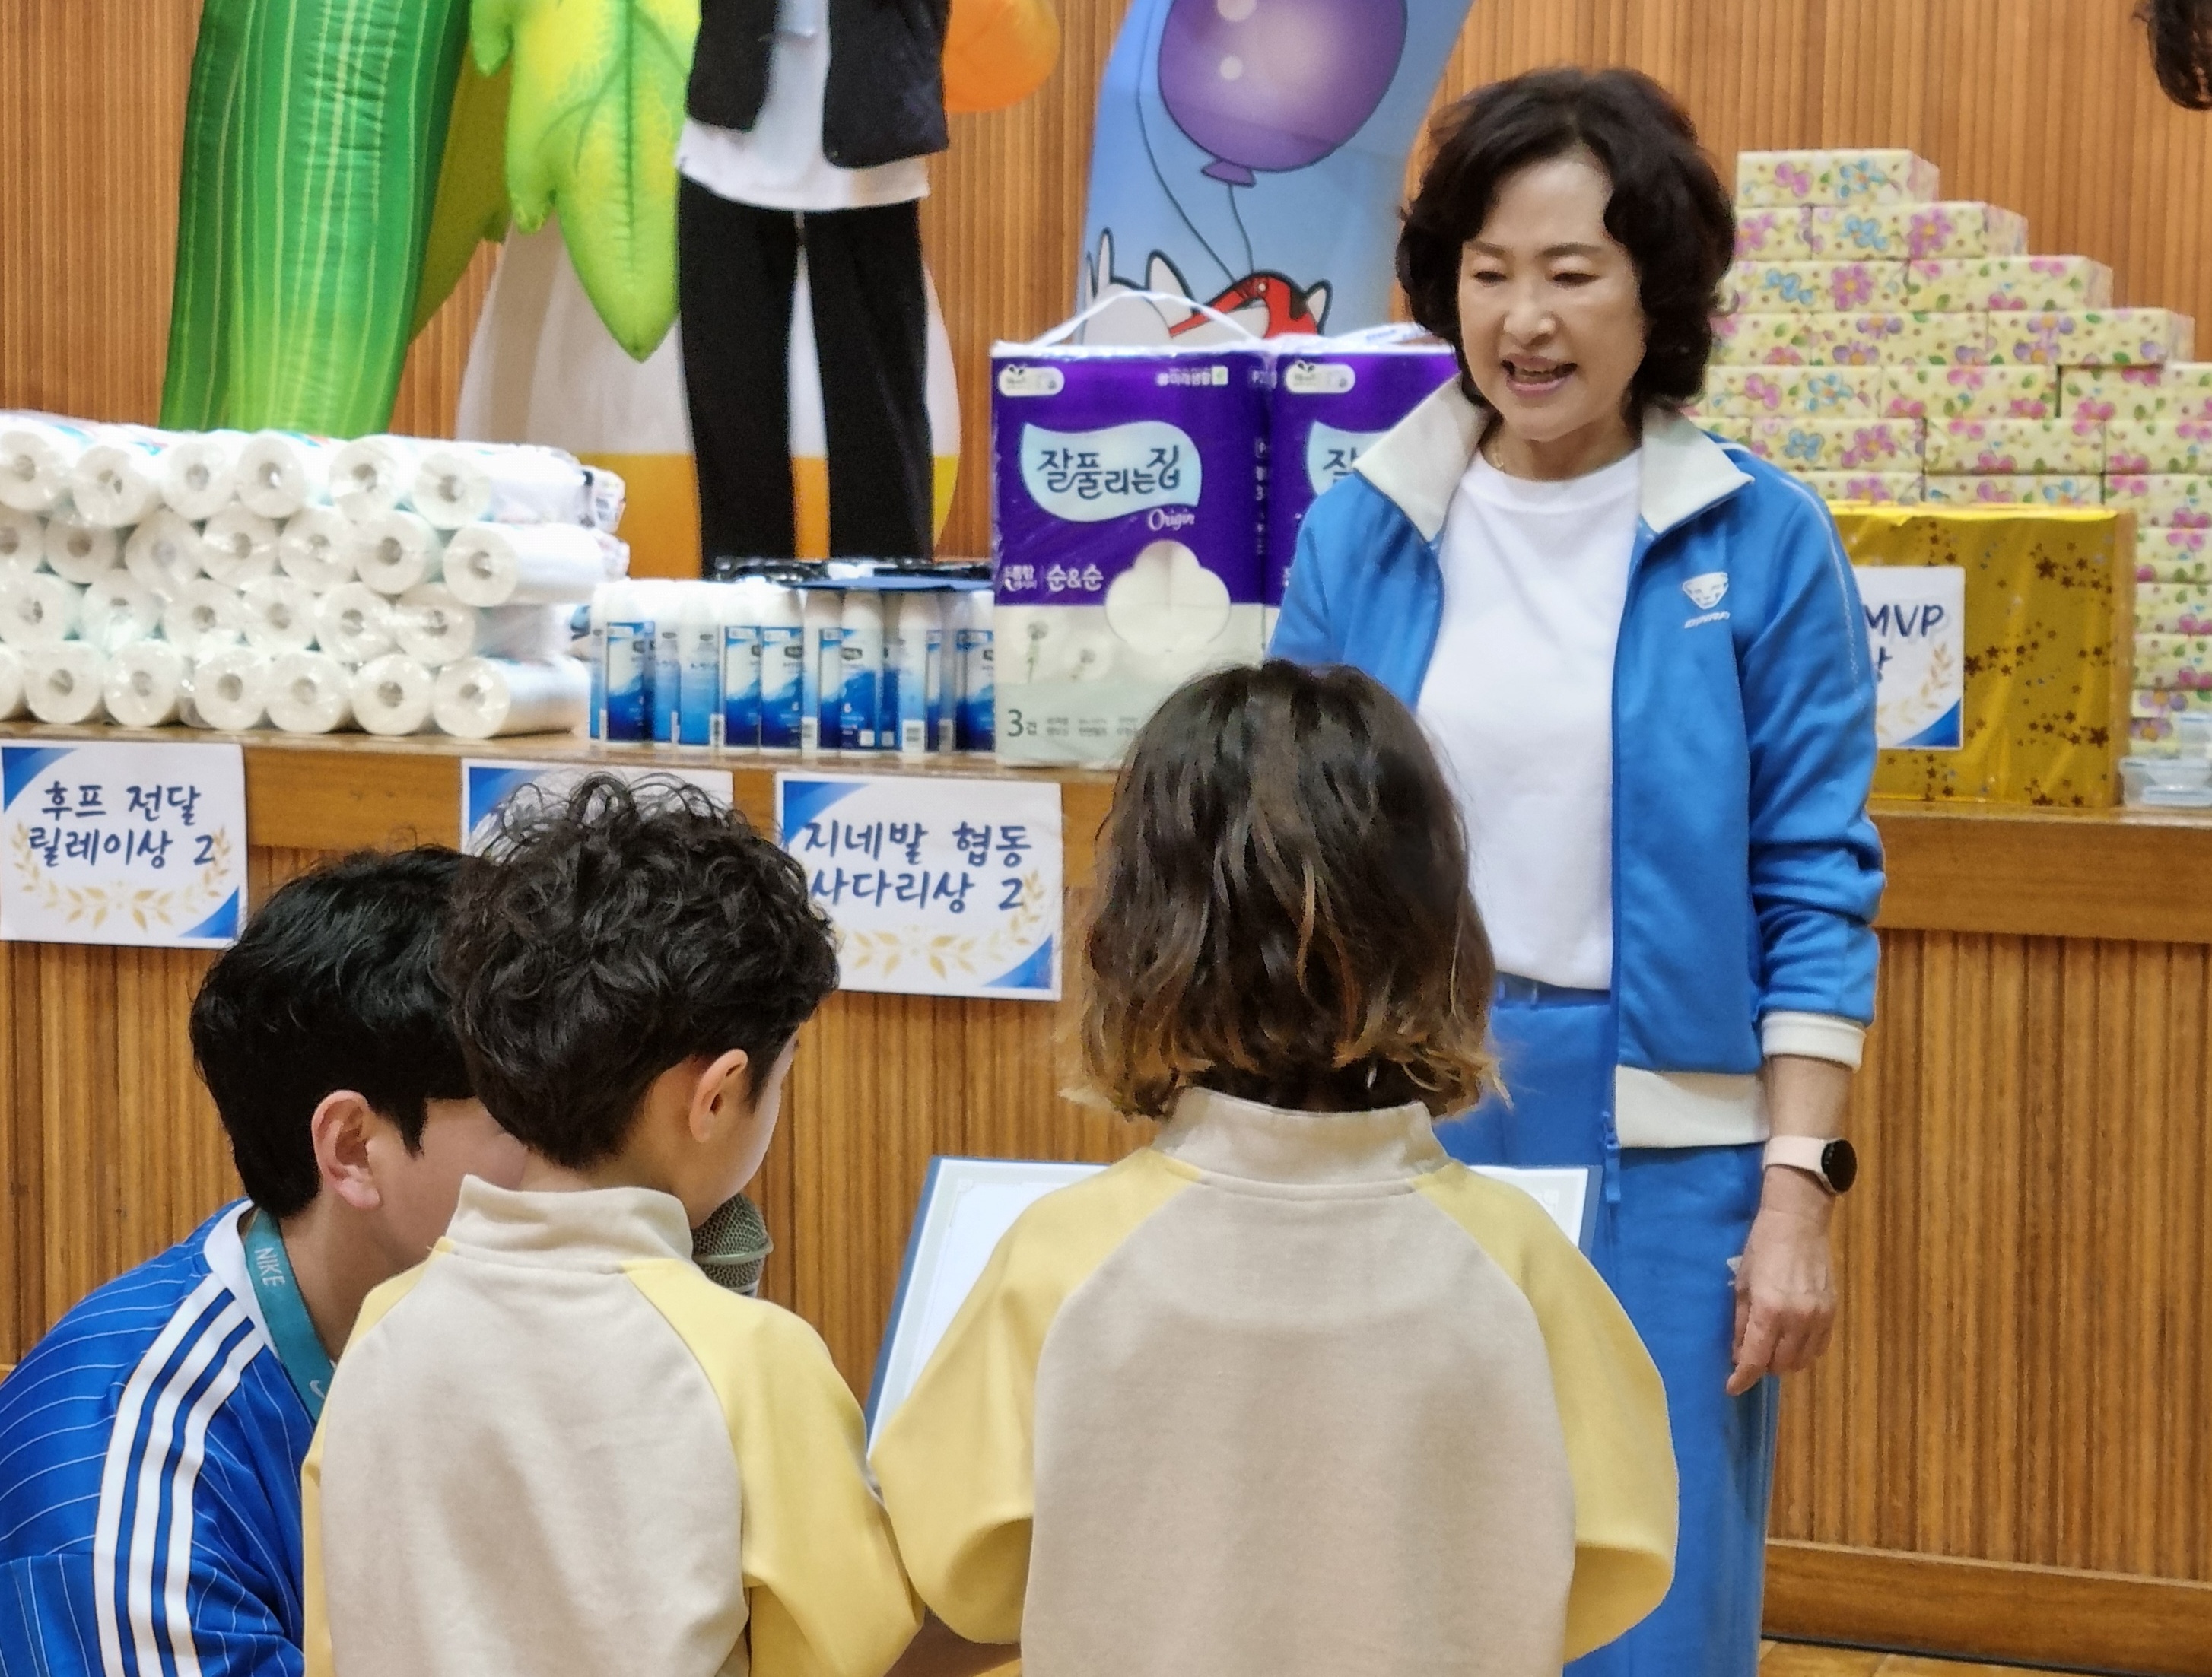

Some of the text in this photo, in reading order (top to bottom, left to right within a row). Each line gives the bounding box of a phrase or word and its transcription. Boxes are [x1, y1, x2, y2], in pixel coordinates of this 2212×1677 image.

[1037, 444, 1181, 500] 잘풀리는집
[1147, 508, 1196, 531] Origin
[1046, 563, 1104, 593] 순&순
[1864, 603, 1945, 638] MVP
[41, 780, 202, 827] 후프 전달
[28, 826, 216, 869] 릴레이상 2
[804, 819, 1033, 869] 지네발 협동
[809, 866, 1025, 914] 사다리상 2
[253, 1246, 286, 1287] NIKE
